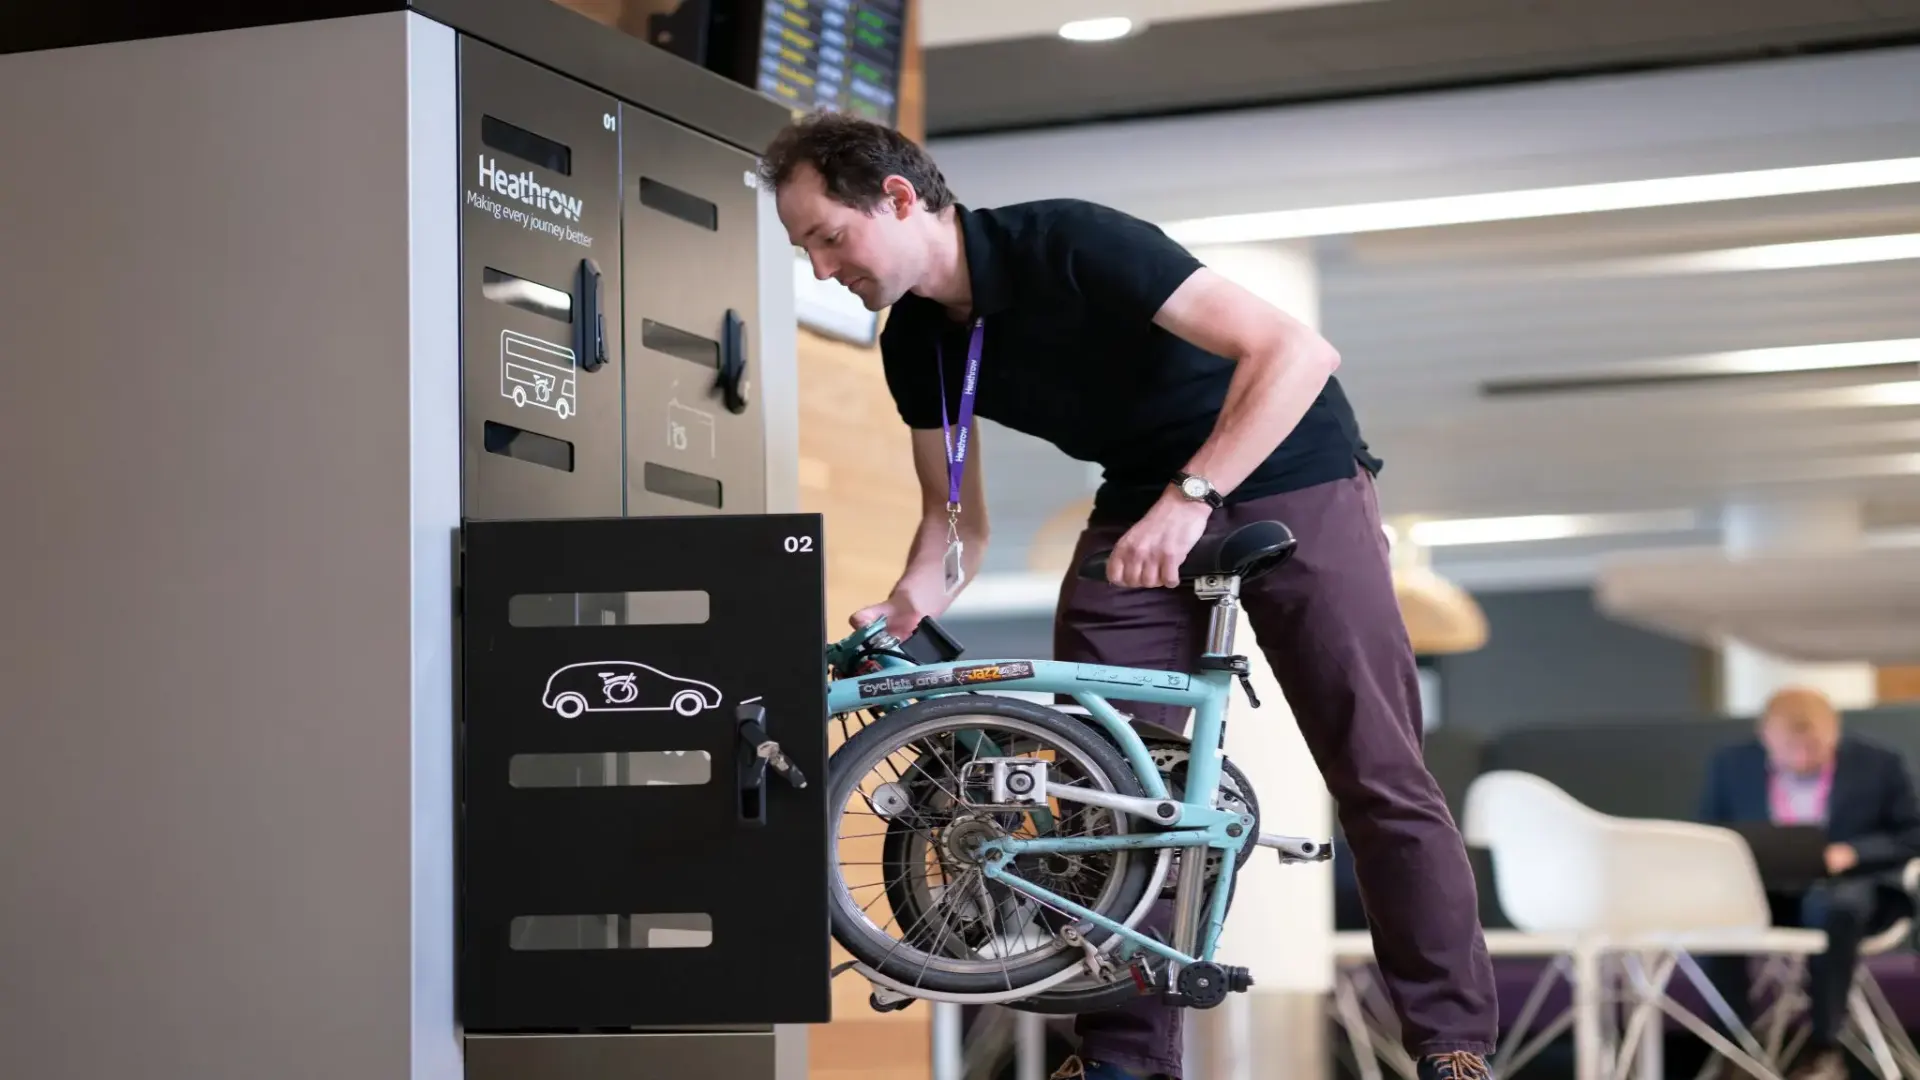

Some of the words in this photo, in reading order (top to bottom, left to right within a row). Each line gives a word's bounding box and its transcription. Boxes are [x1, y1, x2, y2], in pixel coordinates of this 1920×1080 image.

[603, 113, 616, 131] 01
[479, 154, 583, 222] Heathrow
[467, 190, 501, 219] Making
[502, 206, 529, 228] every
[530, 212, 565, 241] journey
[566, 225, 593, 247] better
[964, 360, 977, 395] Heathrow
[955, 426, 967, 462] Heathrow
[784, 536, 813, 552] 02
